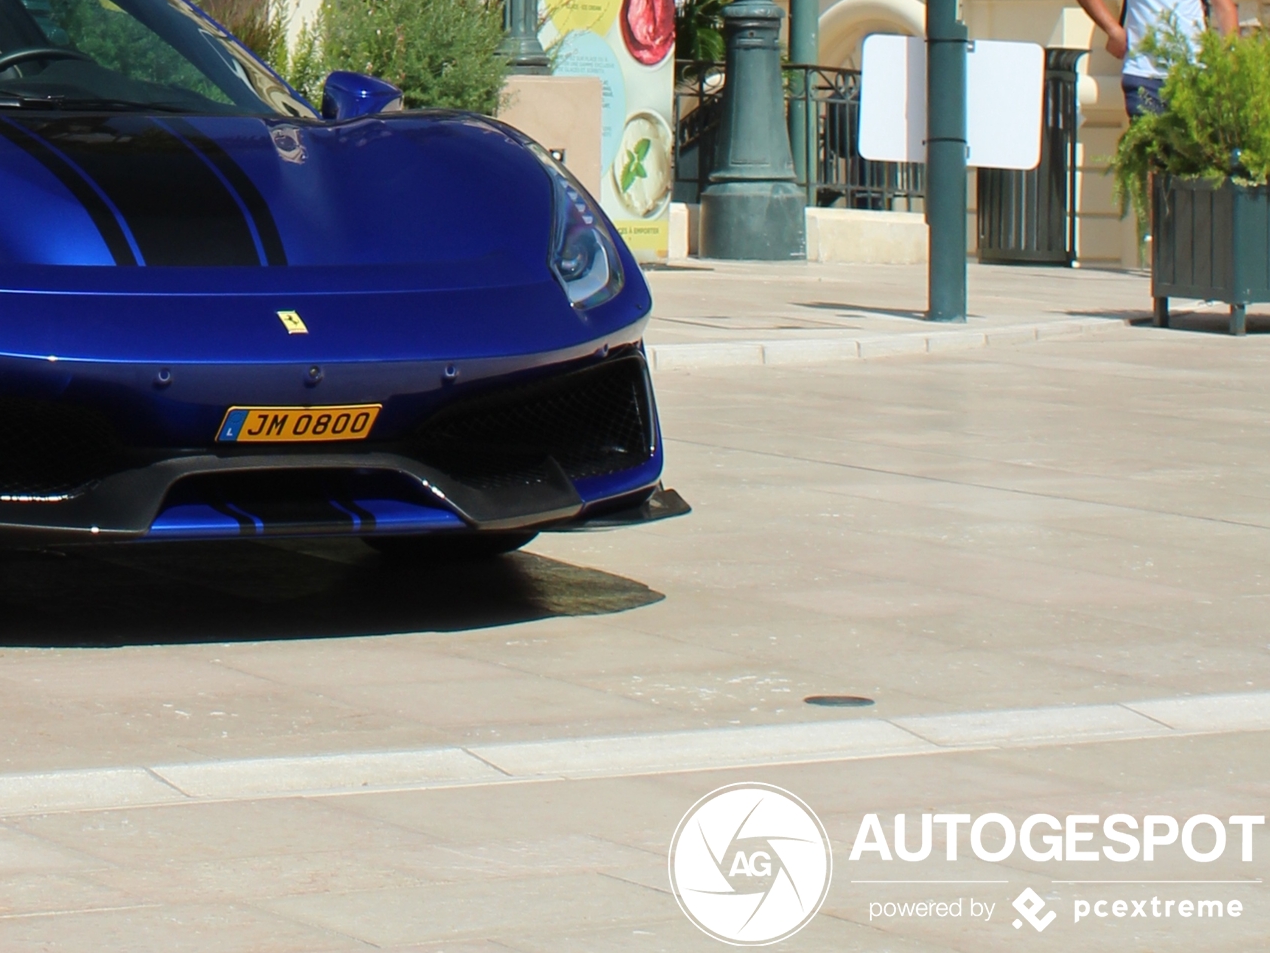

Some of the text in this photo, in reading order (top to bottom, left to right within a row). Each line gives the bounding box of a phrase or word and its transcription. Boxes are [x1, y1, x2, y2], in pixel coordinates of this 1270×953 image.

[226, 427, 233, 436] L
[247, 412, 370, 436] JM 0800
